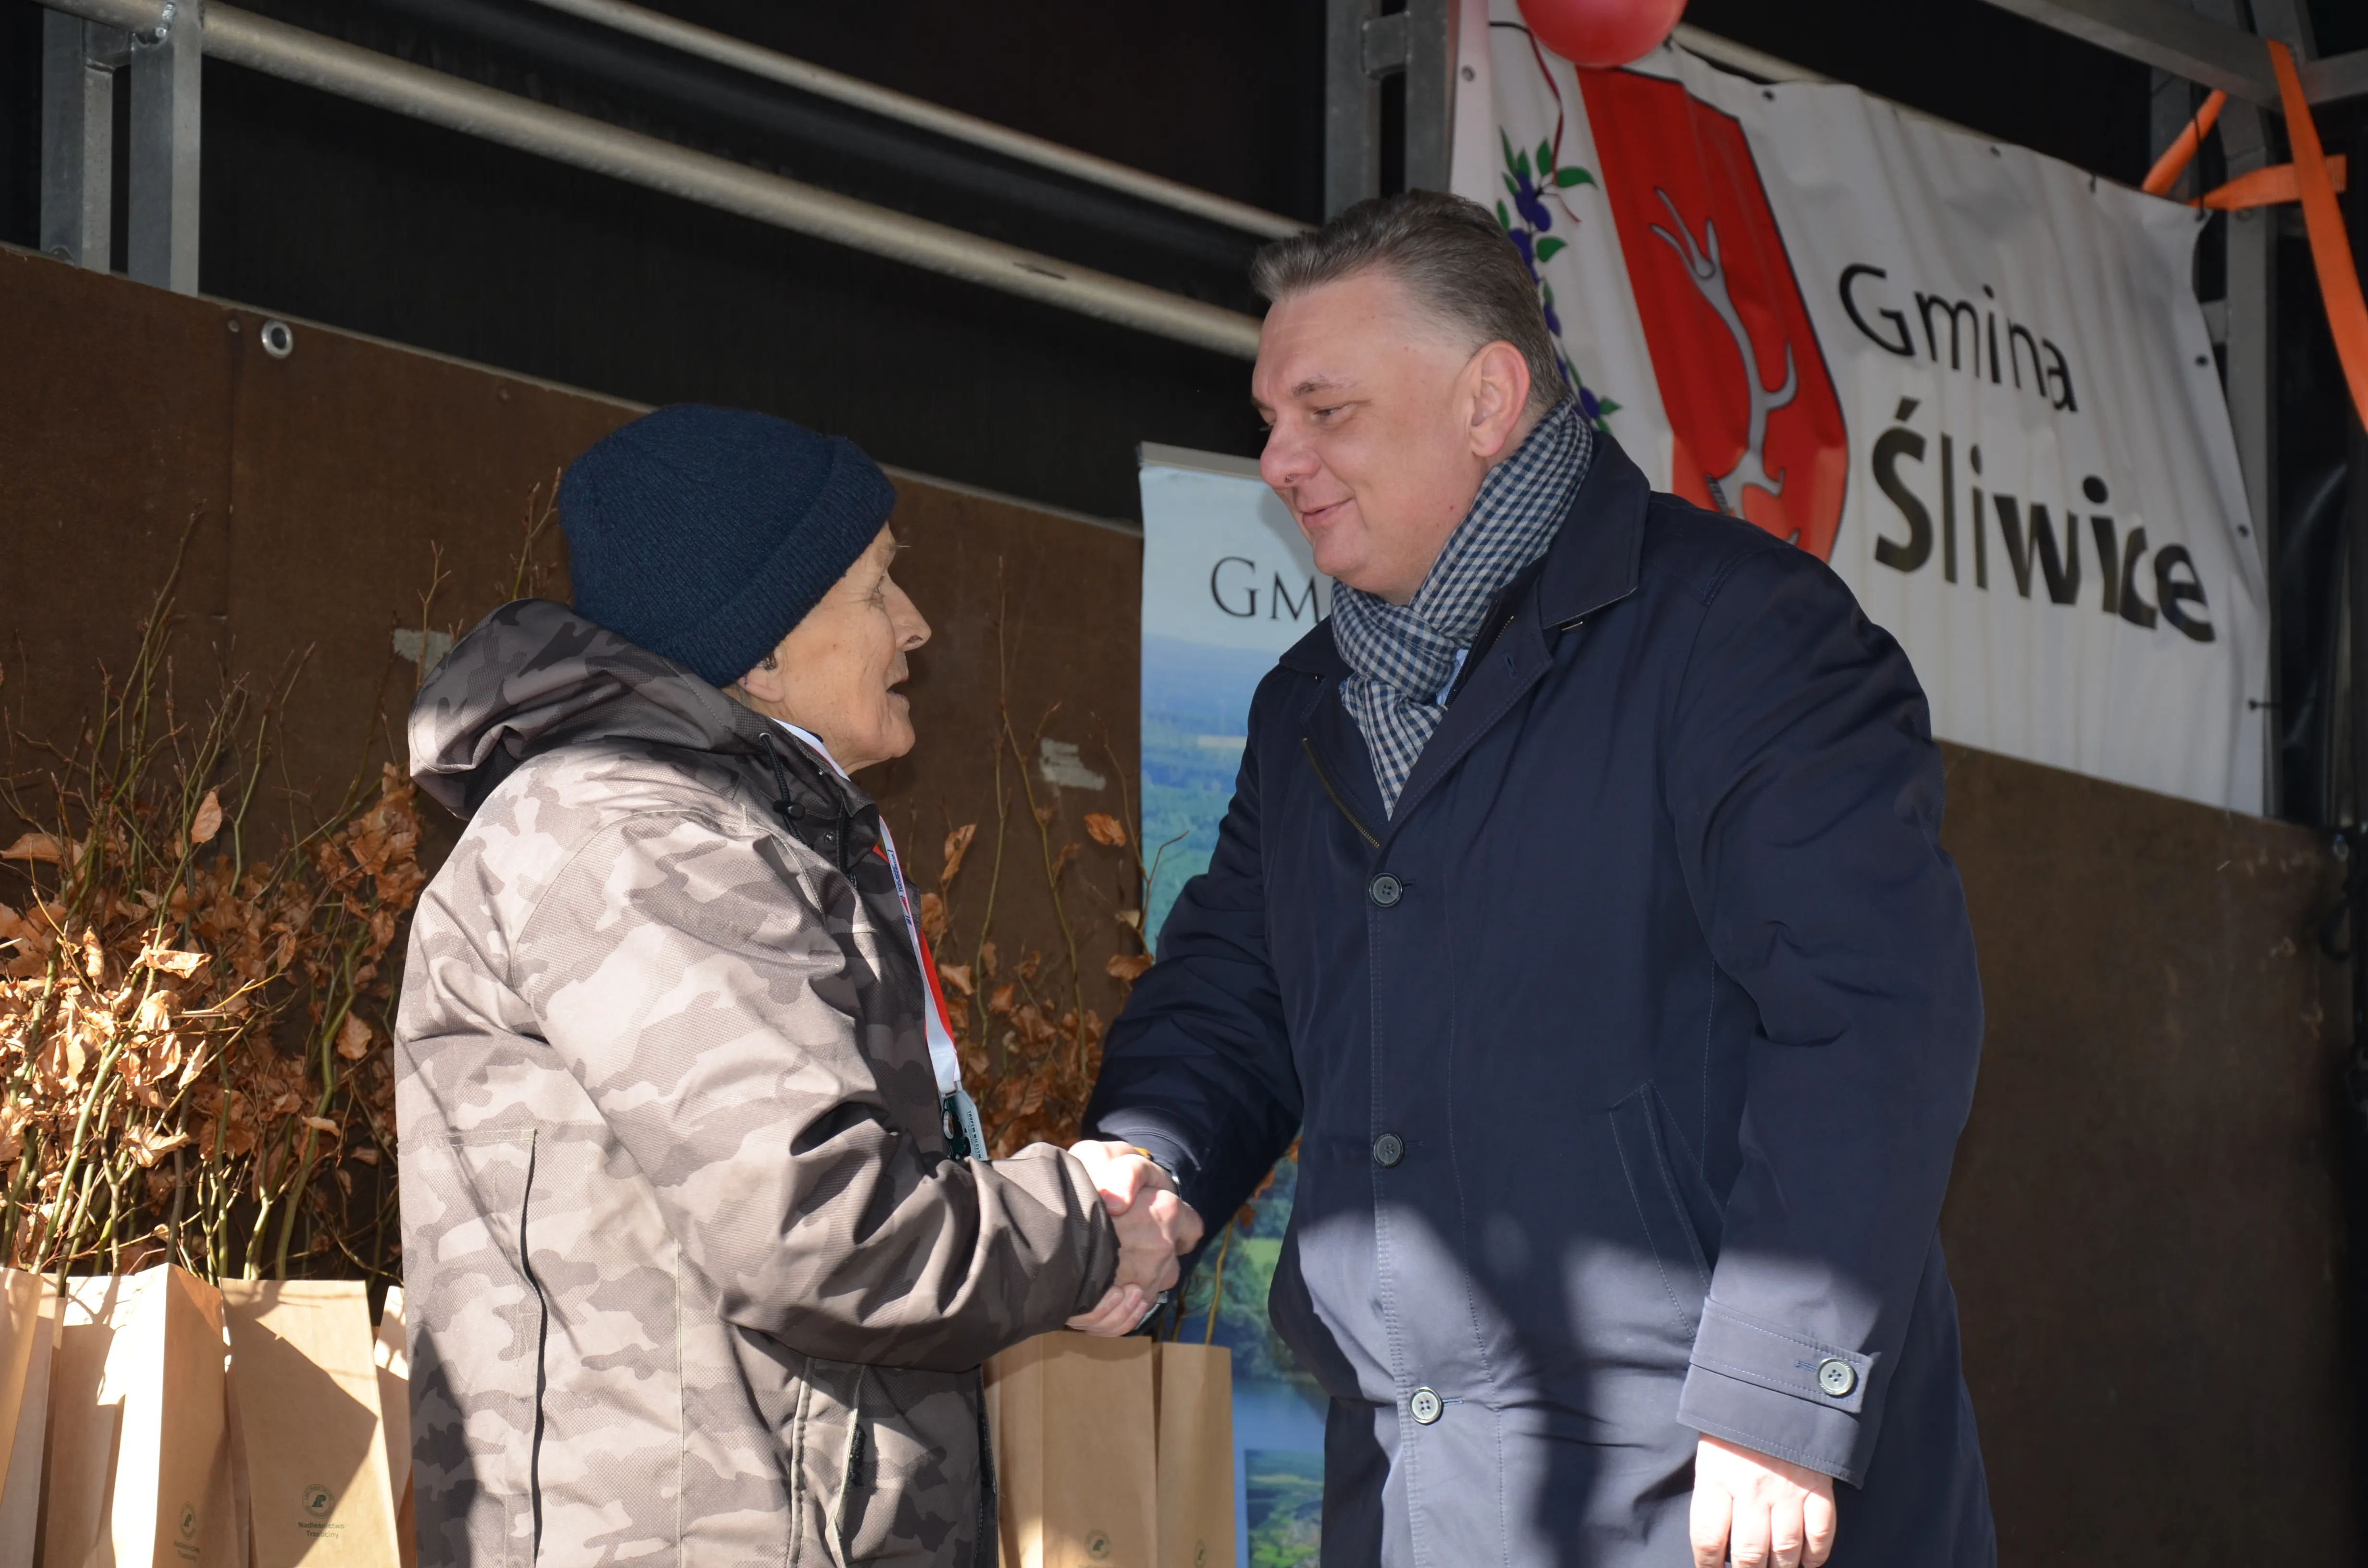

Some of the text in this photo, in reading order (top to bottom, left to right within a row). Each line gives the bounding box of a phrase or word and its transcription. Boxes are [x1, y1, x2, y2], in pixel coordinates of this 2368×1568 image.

[1838, 263, 2078, 412] Gmina
[1871, 396, 2217, 643] Śliwice
[305, 1530, 339, 1539] Trzebciny
